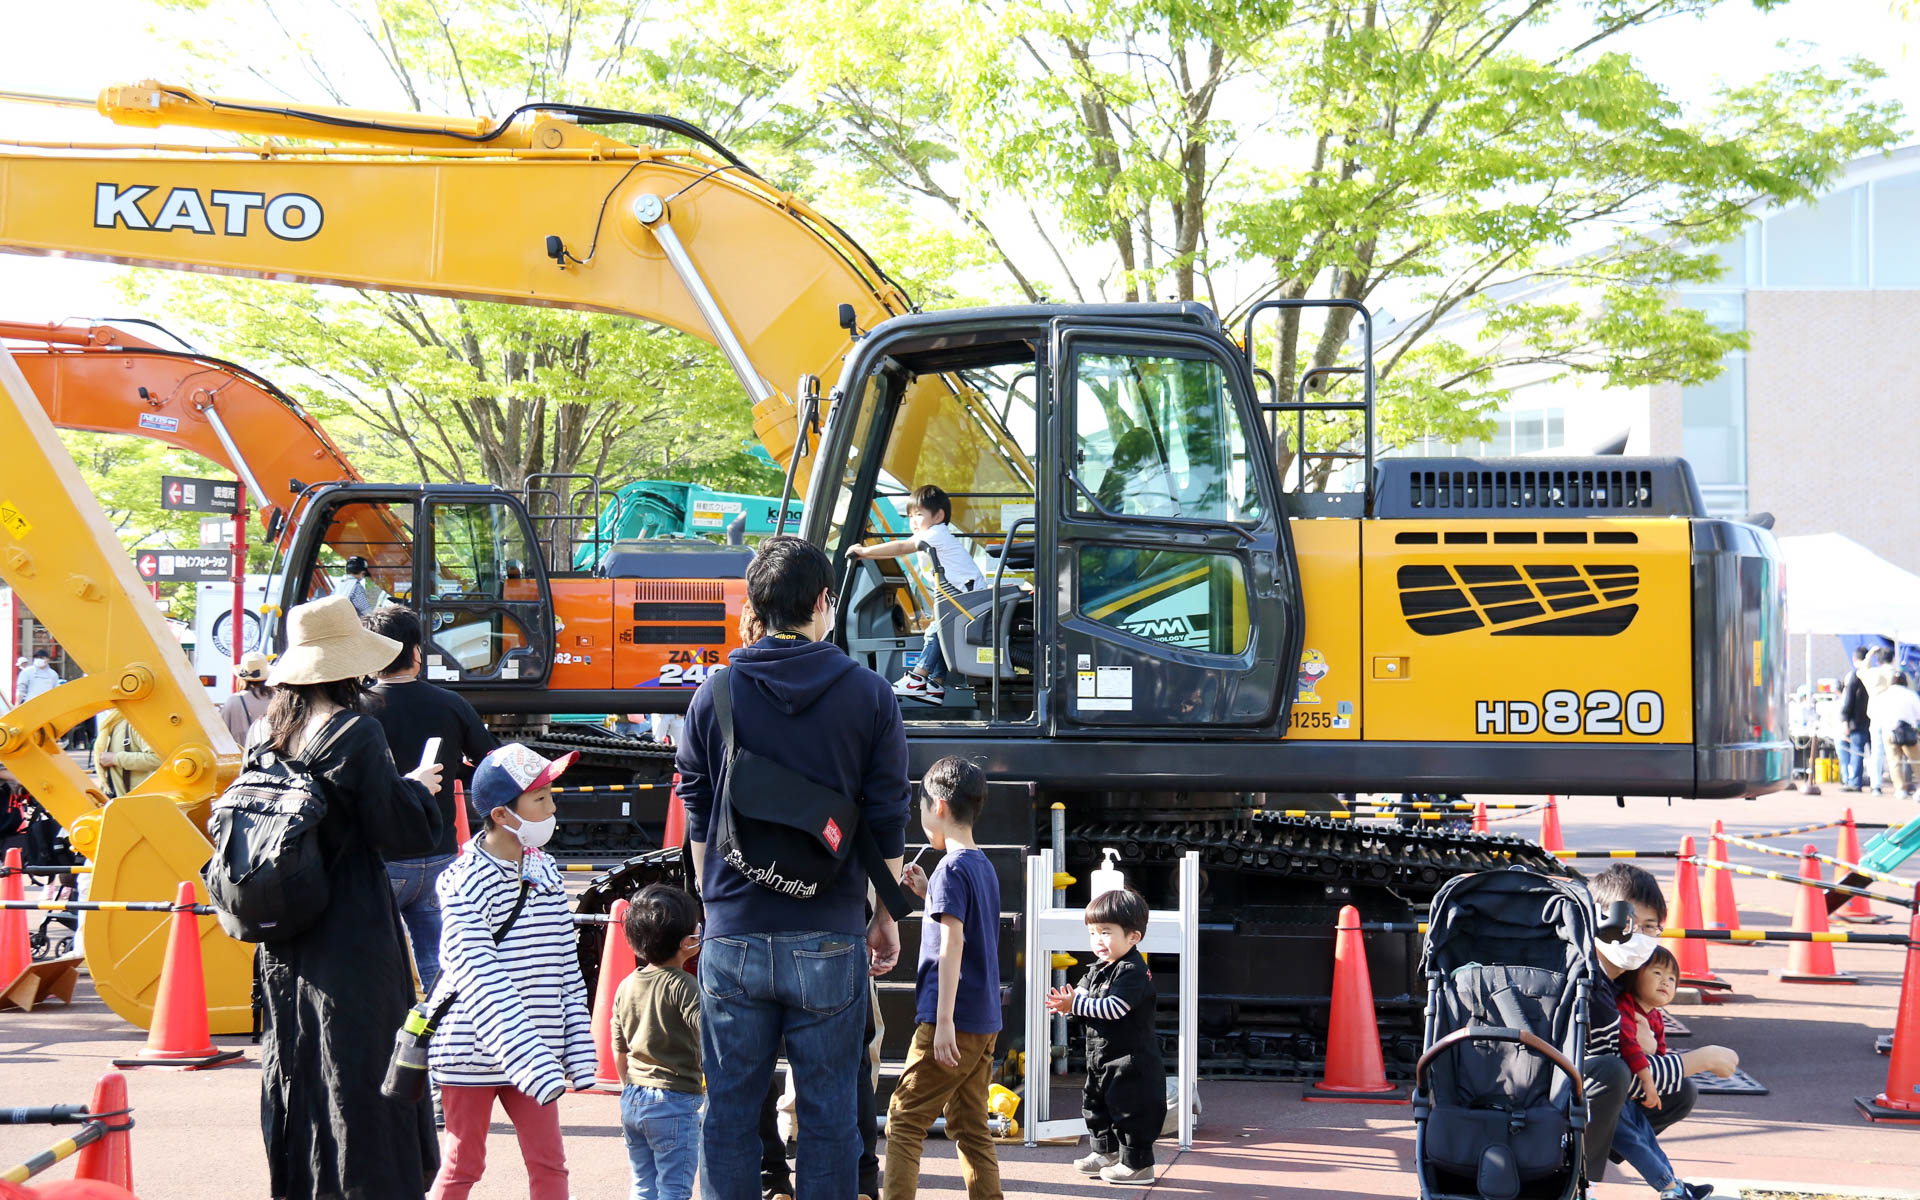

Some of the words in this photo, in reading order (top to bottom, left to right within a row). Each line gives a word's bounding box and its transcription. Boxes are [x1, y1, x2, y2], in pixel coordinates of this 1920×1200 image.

[94, 182, 324, 241] KATO
[669, 648, 719, 664] ZAXIS
[1475, 689, 1665, 736] HD820
